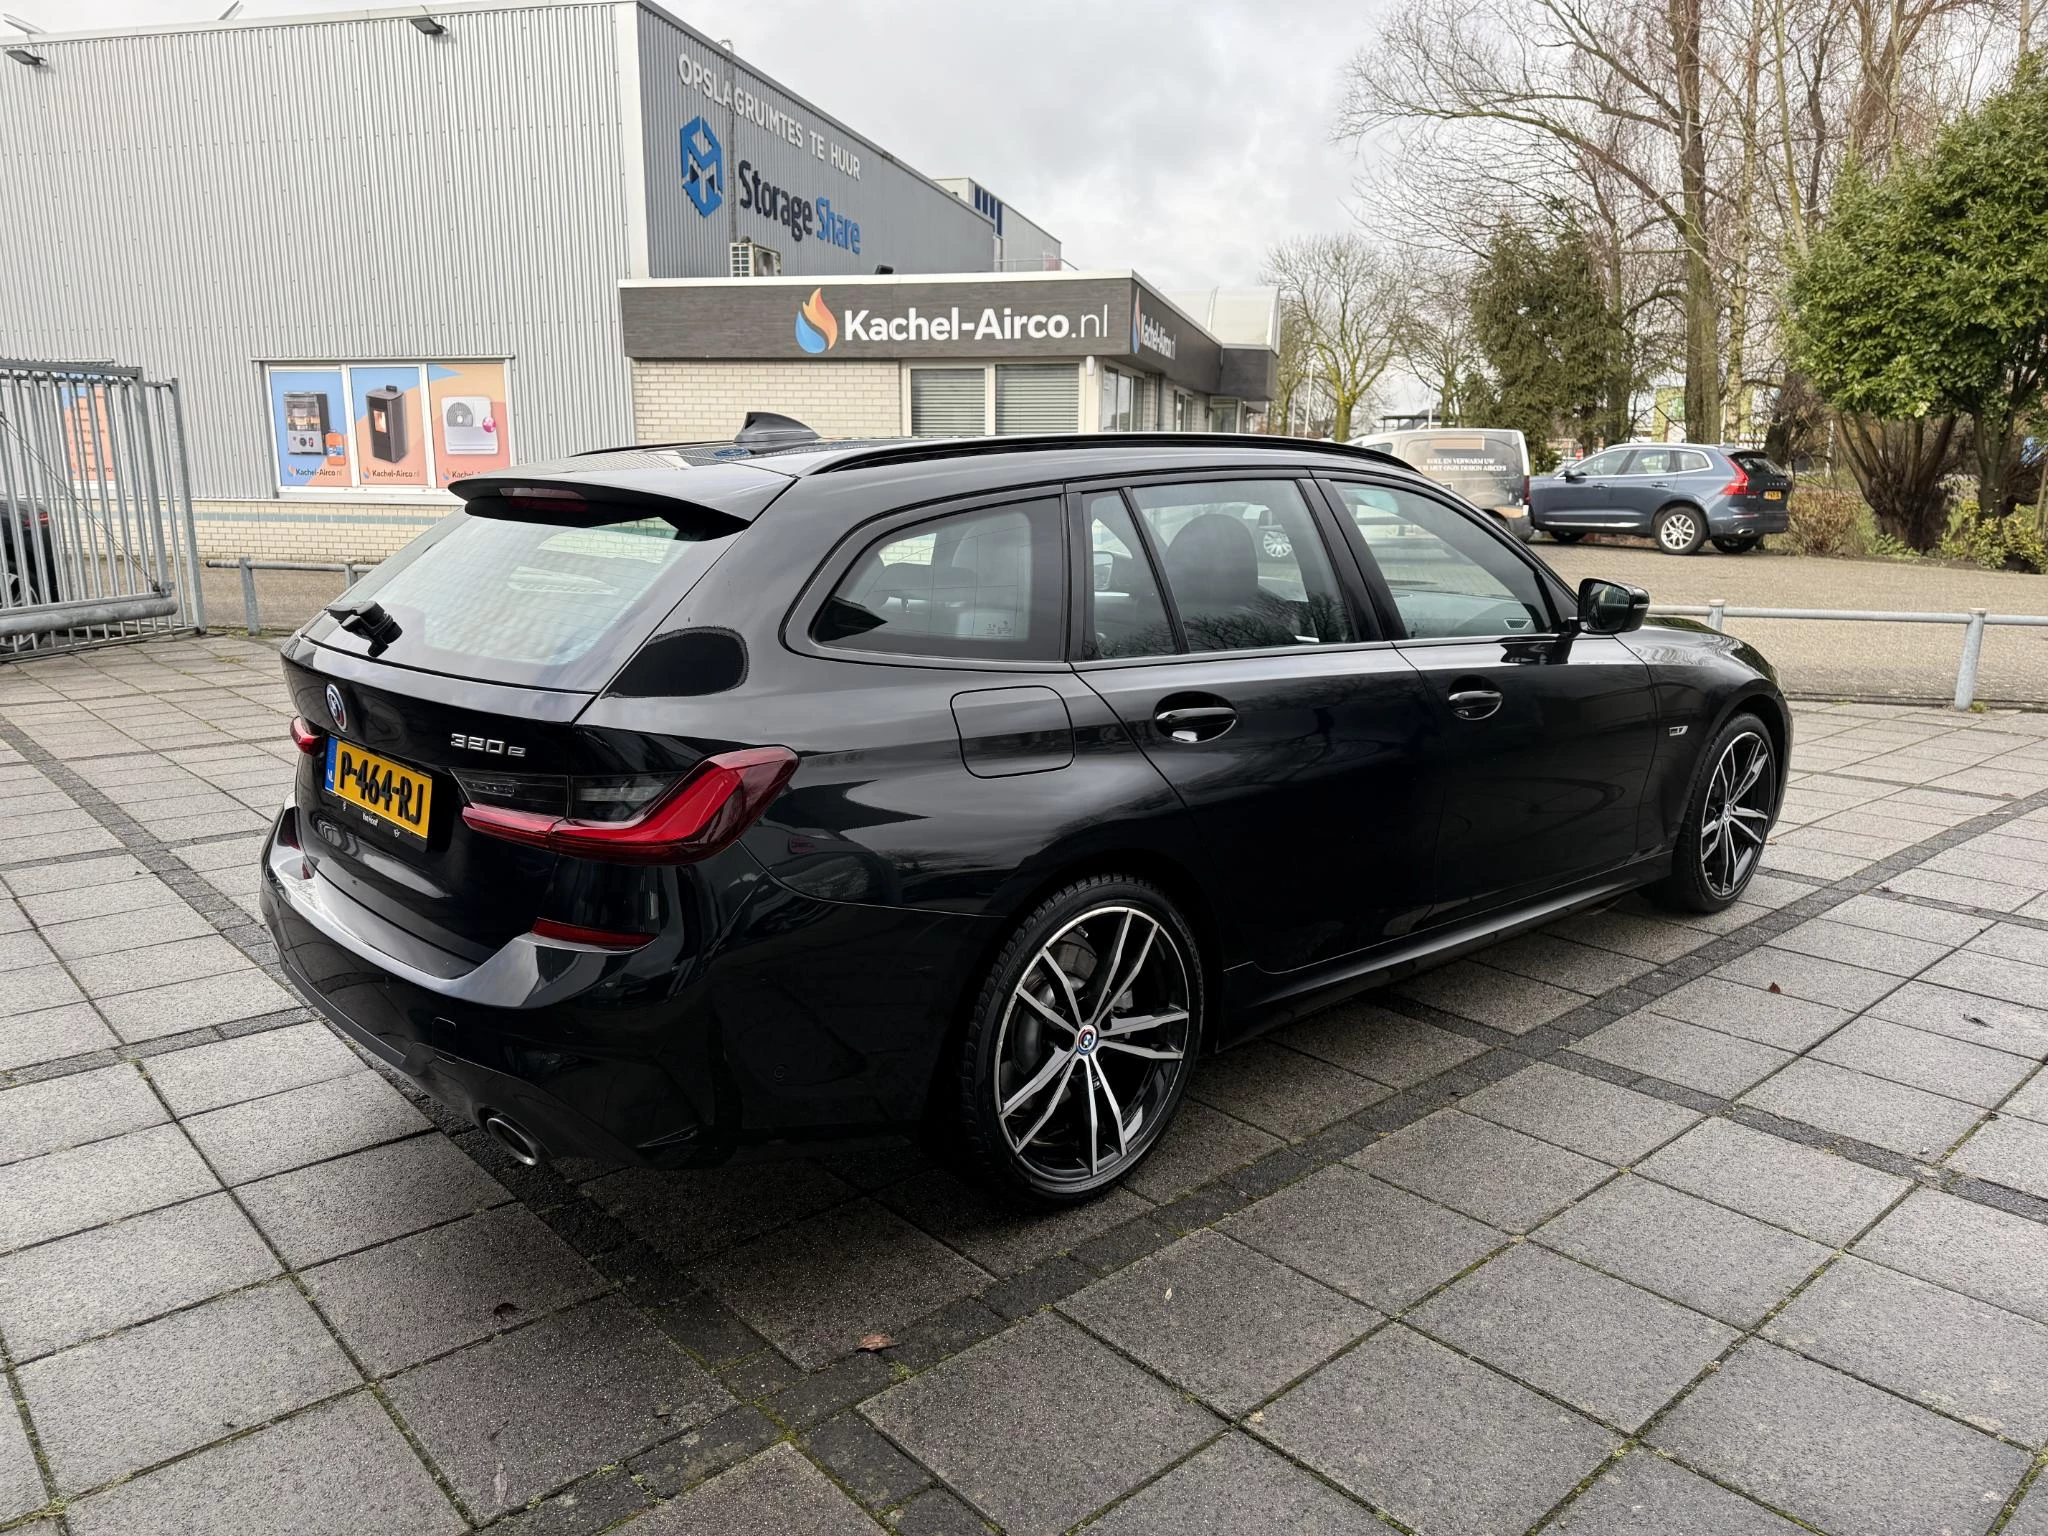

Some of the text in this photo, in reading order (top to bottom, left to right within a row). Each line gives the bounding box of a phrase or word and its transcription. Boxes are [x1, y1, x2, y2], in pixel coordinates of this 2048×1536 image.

[678, 53, 861, 180] OPSLAGRUIMTES TE HUUR
[738, 160, 861, 255] Storage Share
[845, 304, 1108, 341] Kachel-Airco.nl
[339, 751, 424, 825] P-464-RJ
